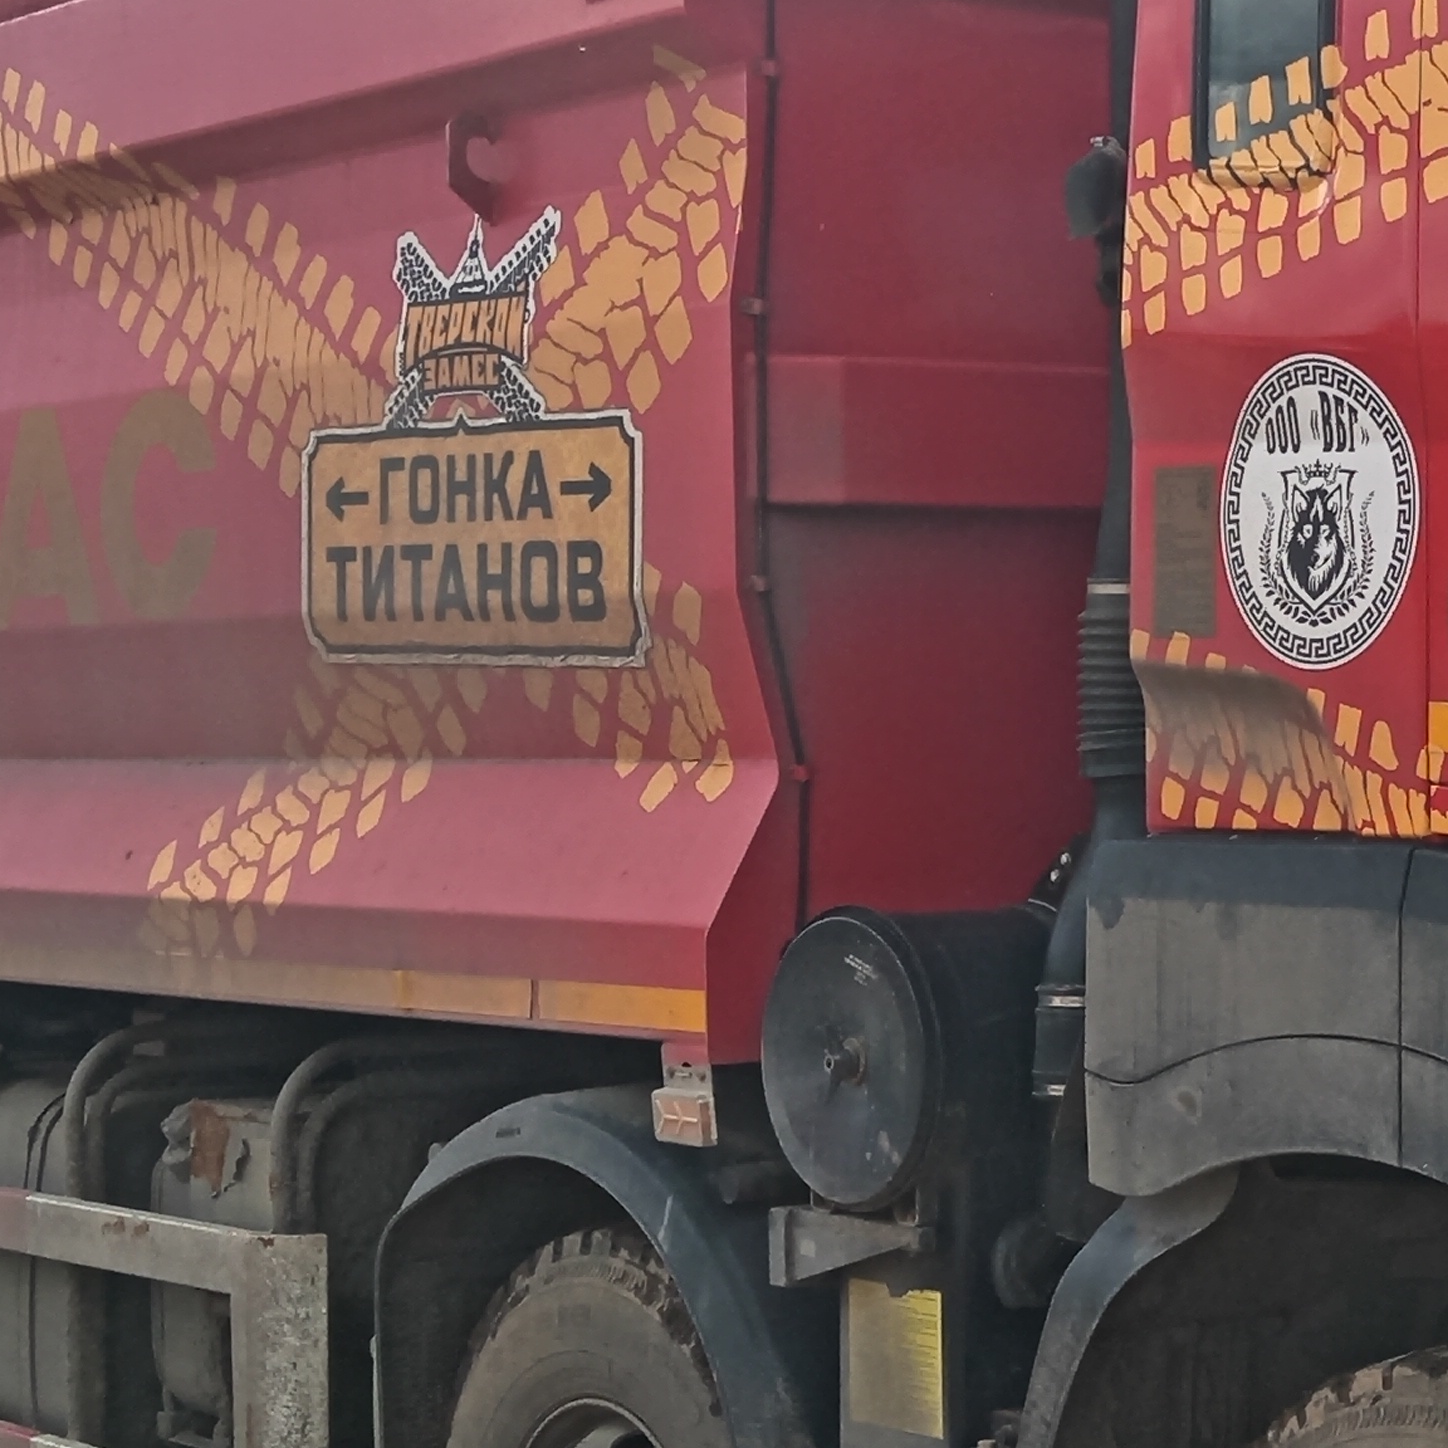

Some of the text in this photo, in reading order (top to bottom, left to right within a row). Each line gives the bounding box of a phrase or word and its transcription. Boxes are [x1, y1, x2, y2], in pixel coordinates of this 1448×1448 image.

[424, 353, 499, 390] ЗАМЕС
[379, 449, 554, 526] ГОНКА
[326, 539, 608, 623] ТИТАНОВ
